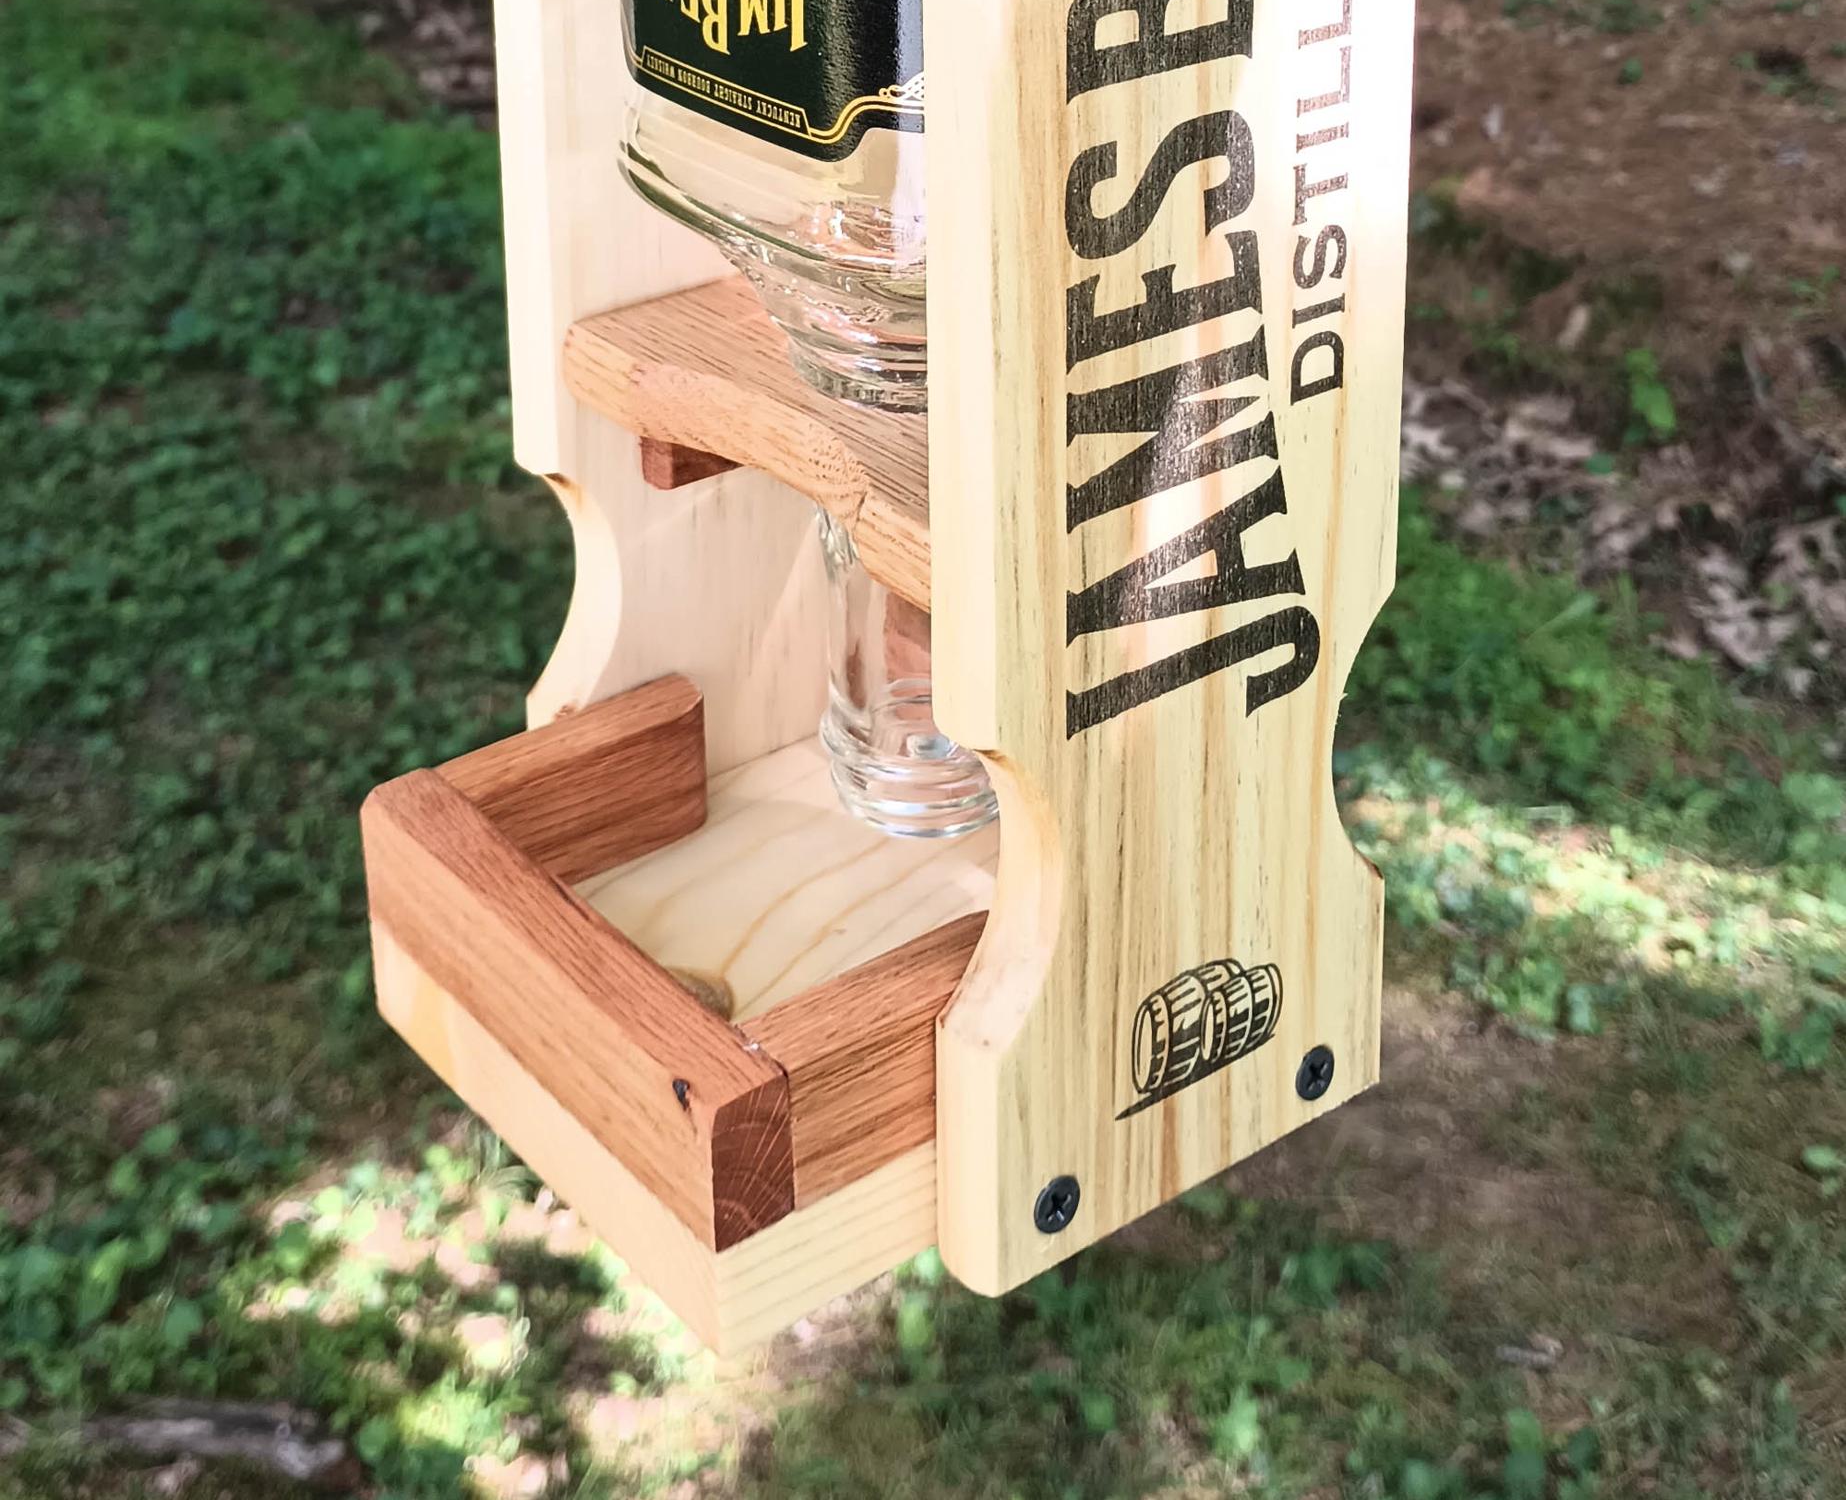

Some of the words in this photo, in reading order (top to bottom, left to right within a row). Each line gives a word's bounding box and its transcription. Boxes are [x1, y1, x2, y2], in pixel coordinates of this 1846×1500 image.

[647, 54, 675, 78] WHISKEY
[678, 68, 710, 93] BOURBON
[714, 84, 752, 110] STRAIGHT
[756, 100, 801, 128] KENTUCKY
[1066, 109, 1321, 740] JAMES
